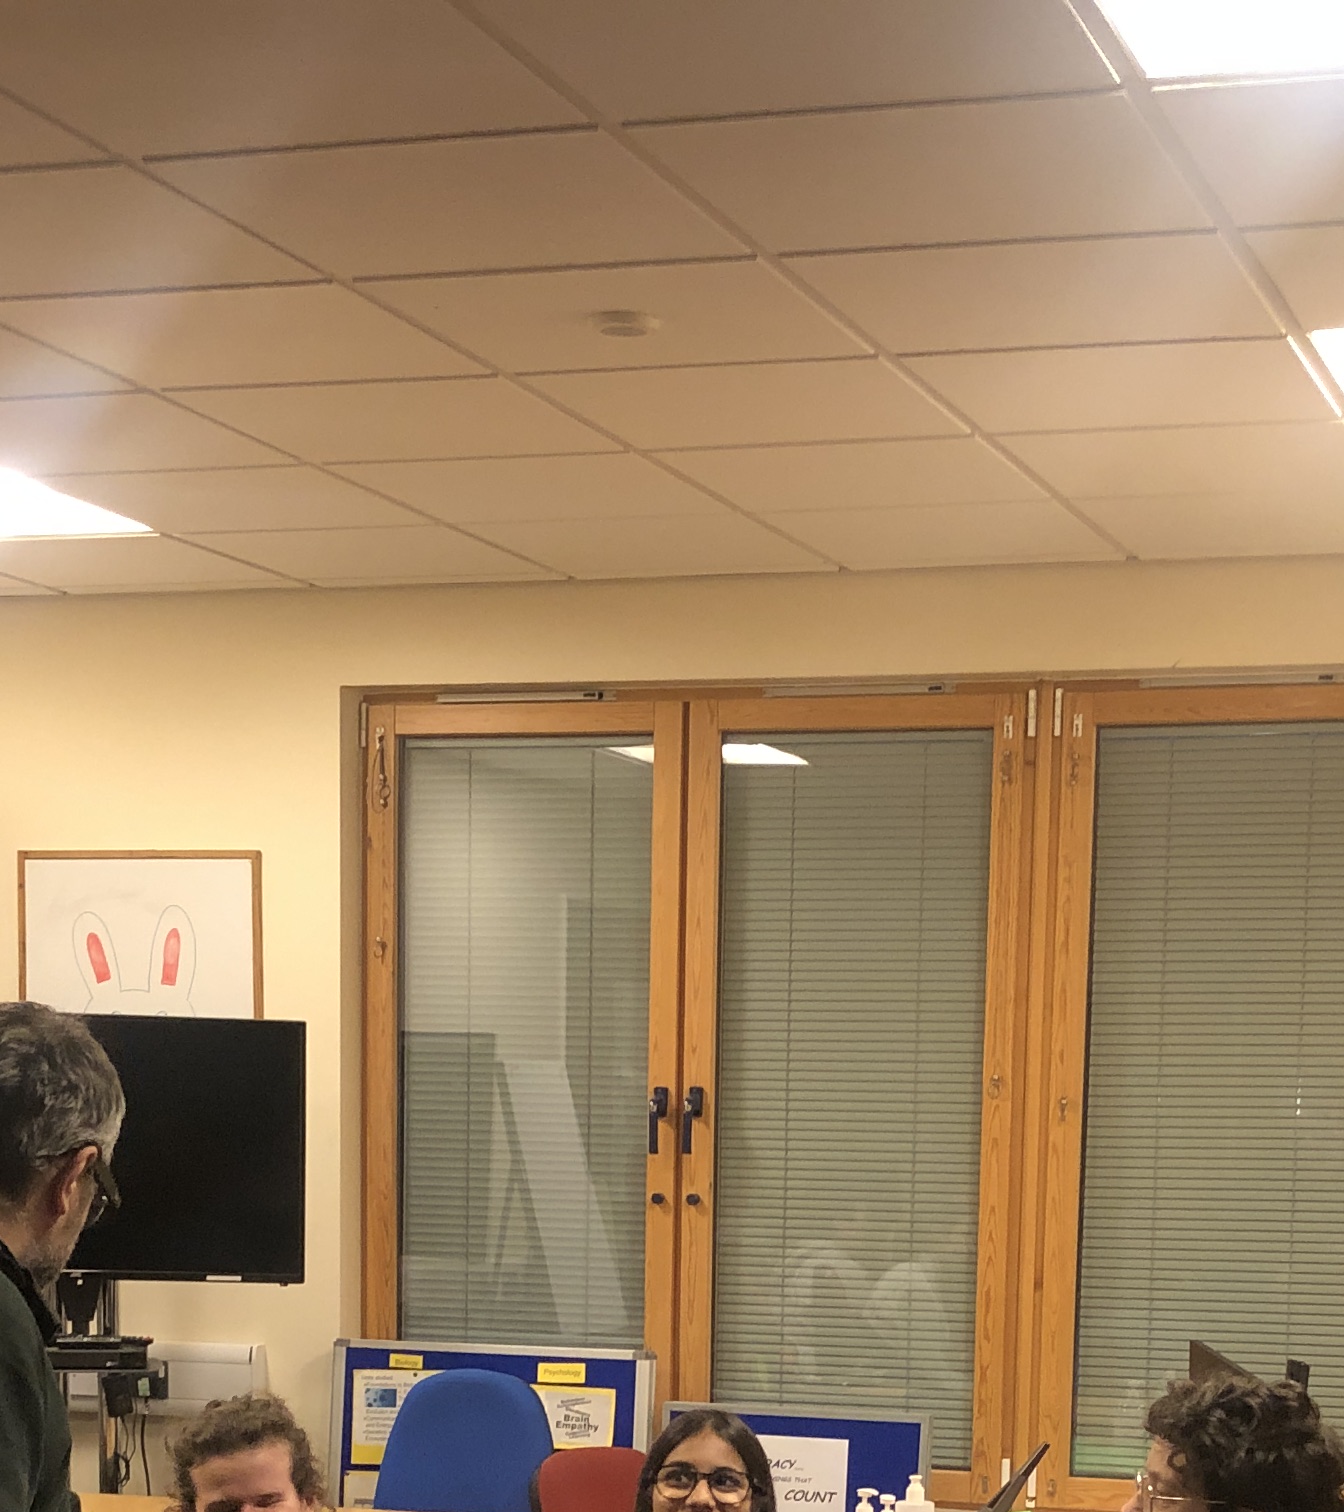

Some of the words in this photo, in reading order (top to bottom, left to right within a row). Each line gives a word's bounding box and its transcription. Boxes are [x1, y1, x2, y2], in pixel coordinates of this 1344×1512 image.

[394, 1358, 419, 1368] Biology
[543, 1368, 582, 1378] Psychology
[563, 1413, 590, 1422] Brain
[555, 1420, 600, 1432] Empathy
[794, 1476, 813, 1484] THAT
[784, 1489, 838, 1504] COUNT
